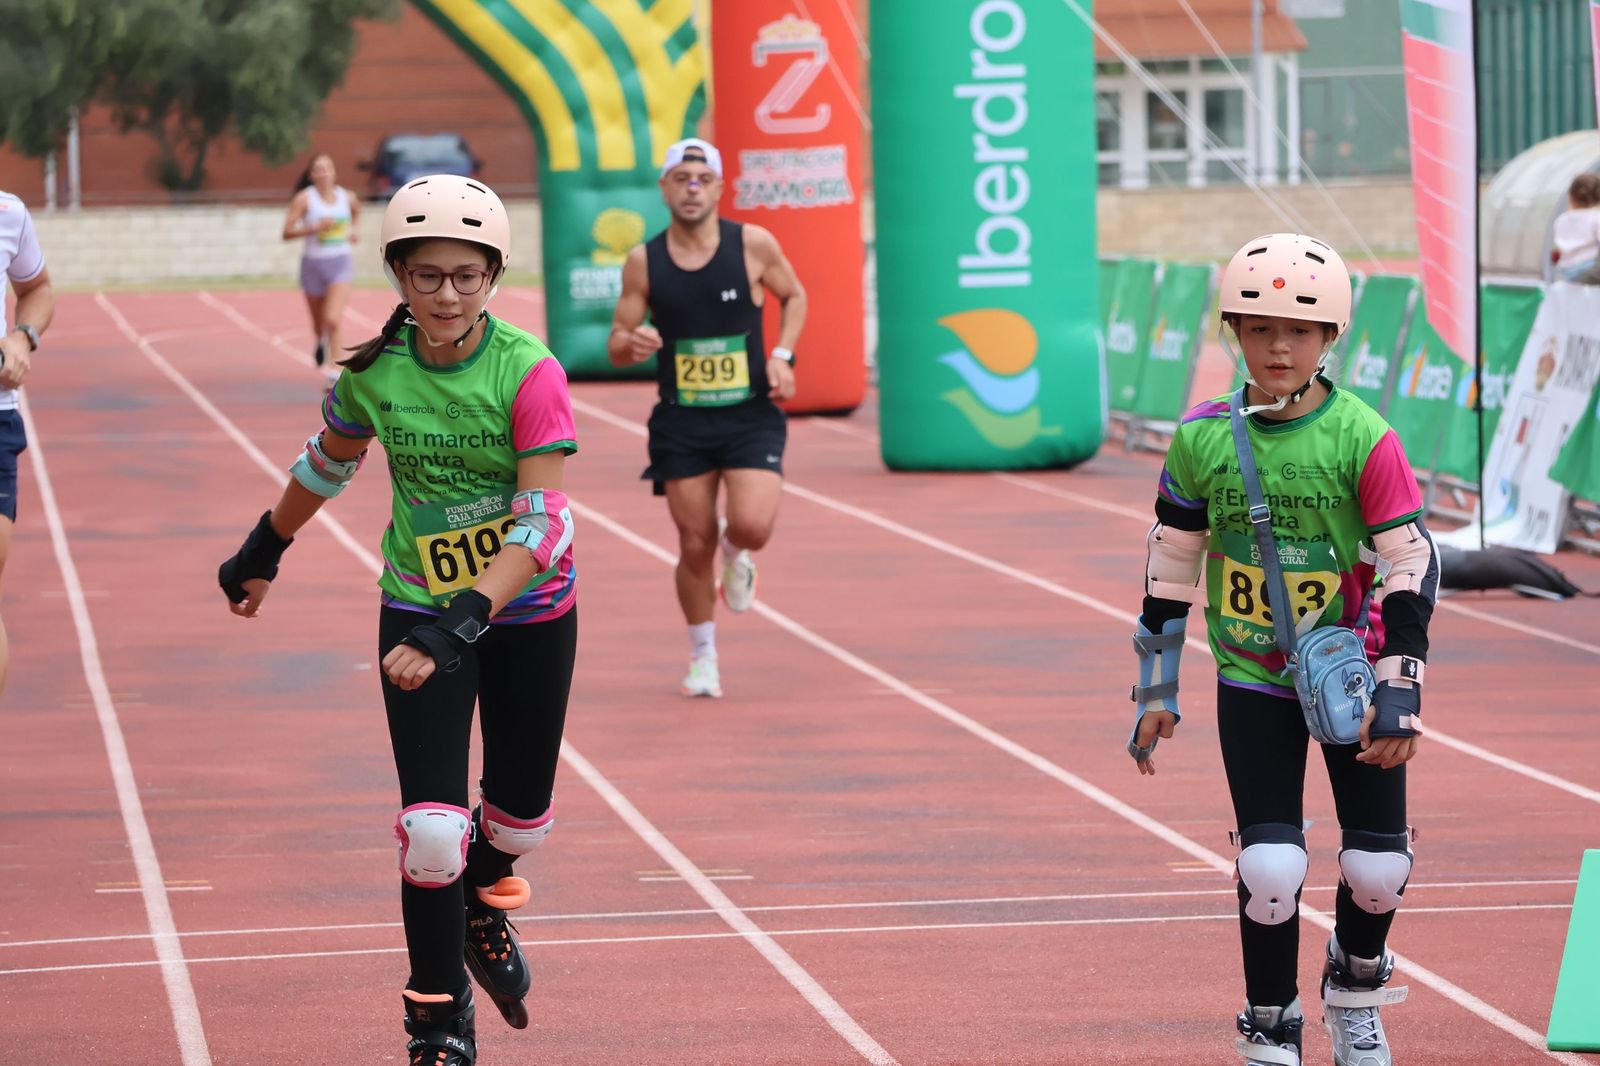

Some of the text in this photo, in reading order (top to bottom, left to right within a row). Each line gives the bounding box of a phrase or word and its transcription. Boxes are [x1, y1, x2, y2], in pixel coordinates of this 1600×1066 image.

[735, 177, 854, 209] ZAMORA
[682, 357, 735, 383] 299
[393, 403, 435, 415] Iberdrola
[392, 427, 508, 449] En marcha
[395, 451, 466, 469] contra
[426, 468, 501, 485] cáncer
[1264, 492, 1343, 510] marcha
[447, 512, 472, 524] CAJA
[472, 502, 506, 519] RURAL
[1227, 510, 1300, 530] cotra
[470, 916, 493, 929] FILA
[446, 1036, 466, 1051] FILA
